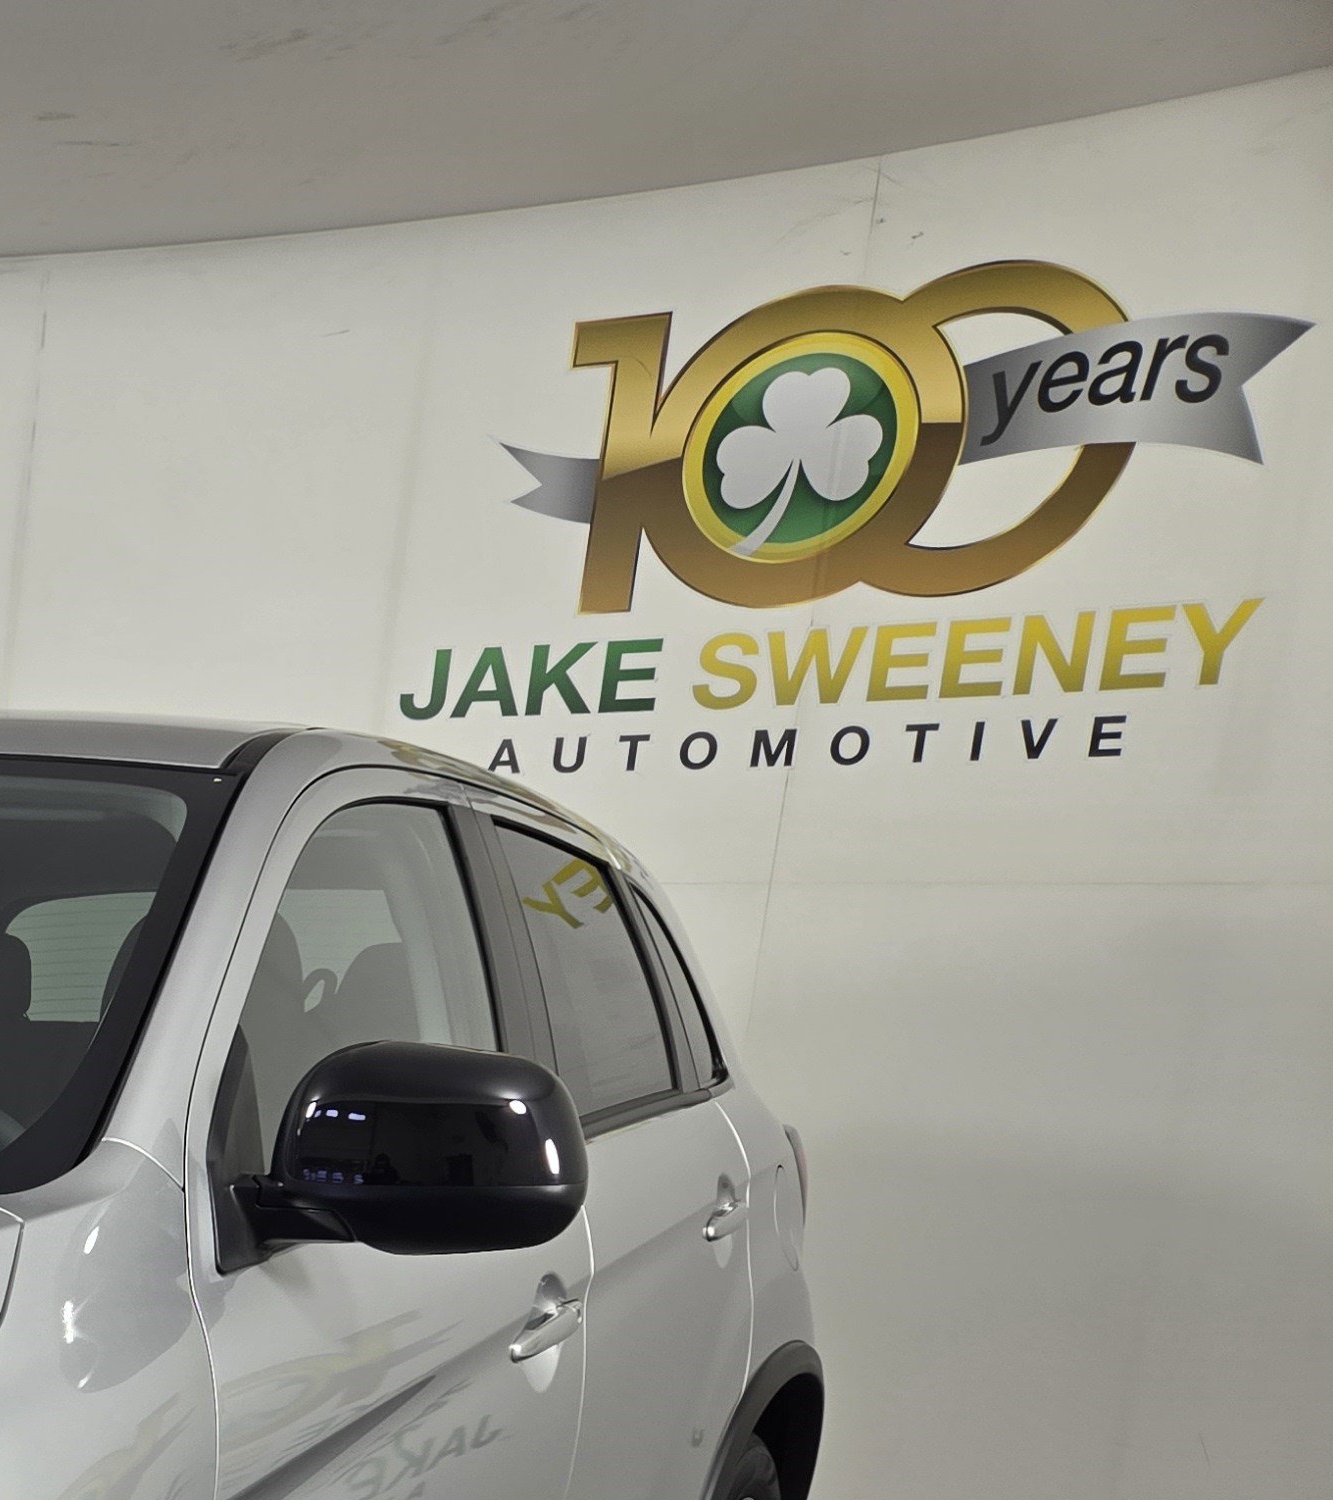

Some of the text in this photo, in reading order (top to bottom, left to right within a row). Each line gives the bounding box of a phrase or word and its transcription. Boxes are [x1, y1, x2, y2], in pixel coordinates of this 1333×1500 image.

[571, 258, 1230, 615] 100 years
[399, 597, 1267, 720] JAKE SWEENEY
[488, 714, 1128, 775] AUTOMOTIVE
